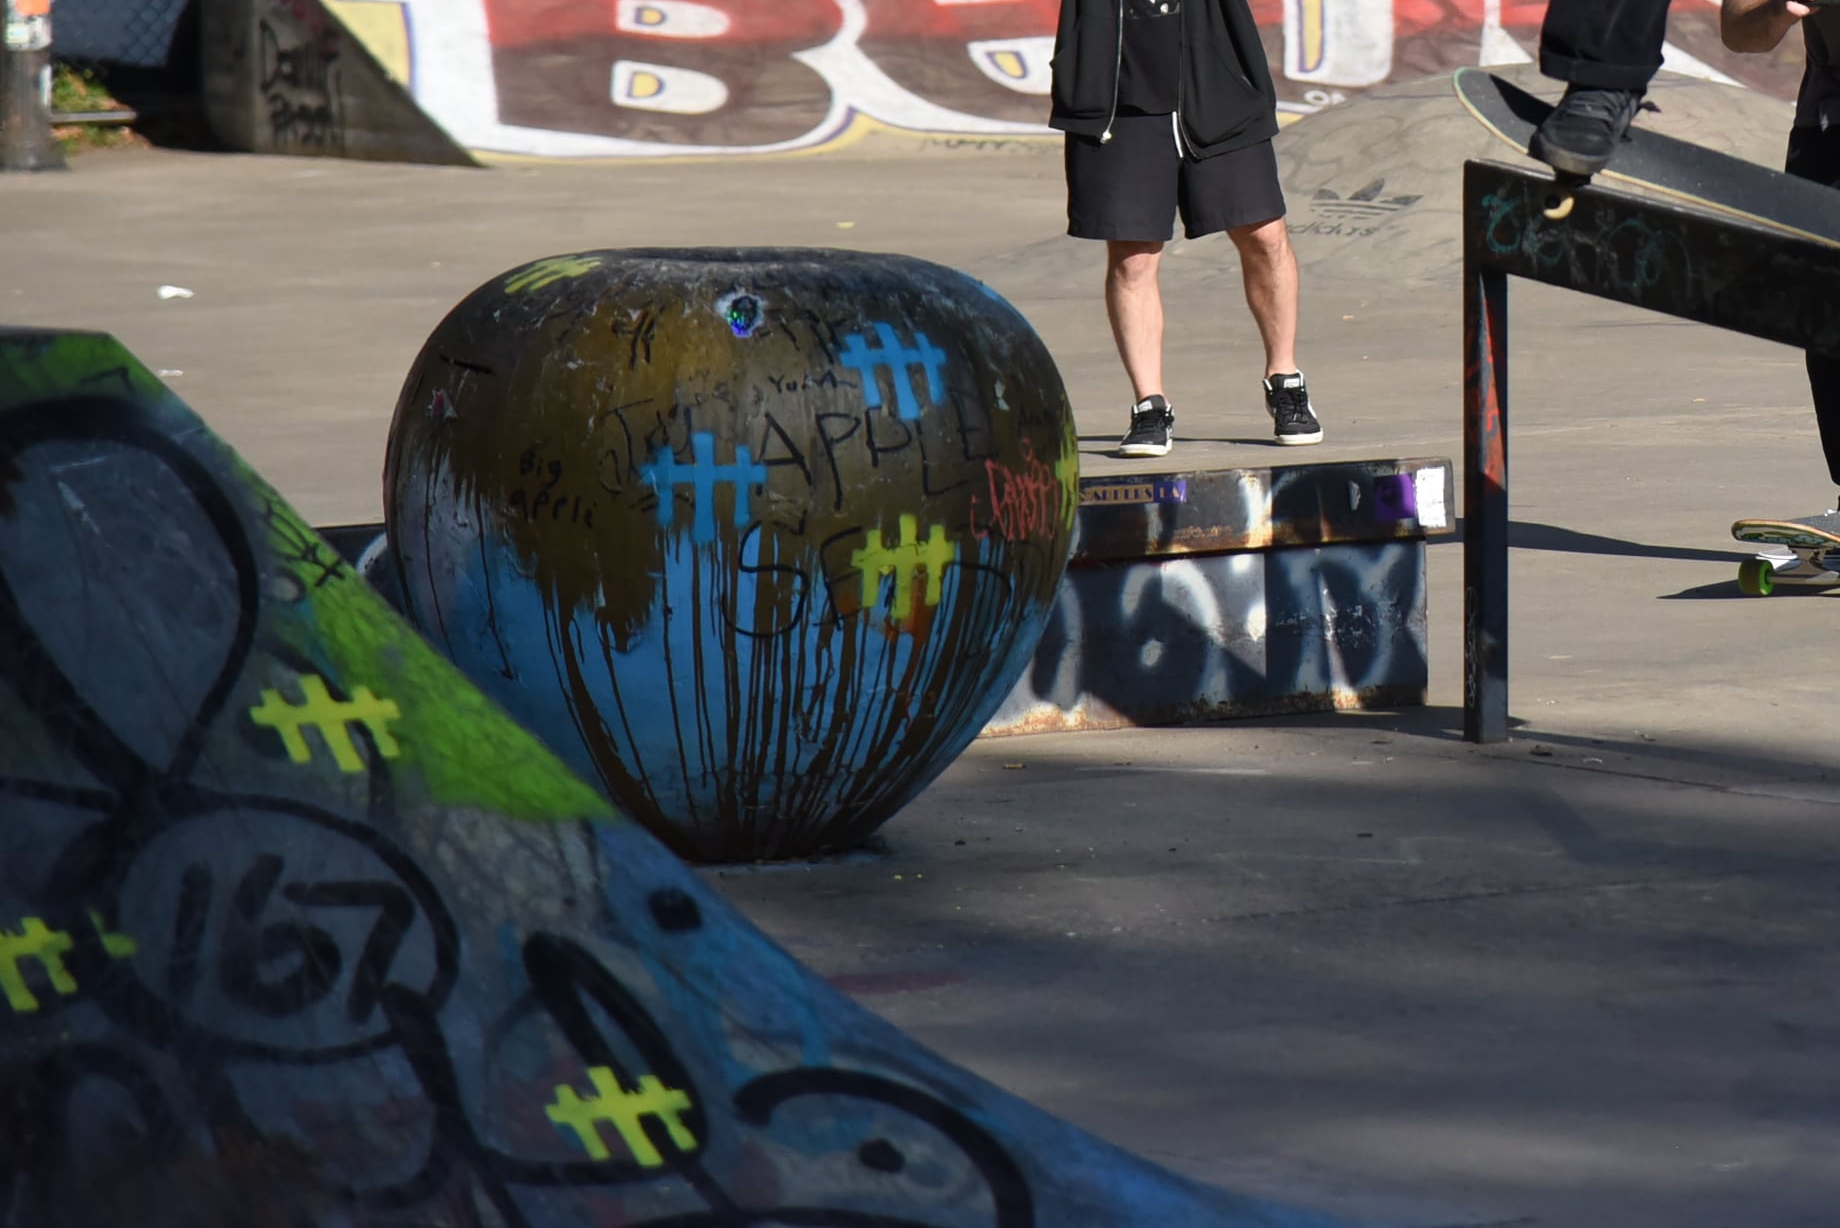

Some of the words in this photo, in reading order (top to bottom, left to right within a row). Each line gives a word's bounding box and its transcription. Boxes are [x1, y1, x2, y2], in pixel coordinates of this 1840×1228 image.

[520, 448, 563, 490] Big
[755, 387, 998, 511] APPLE
[169, 854, 417, 1023] 167
